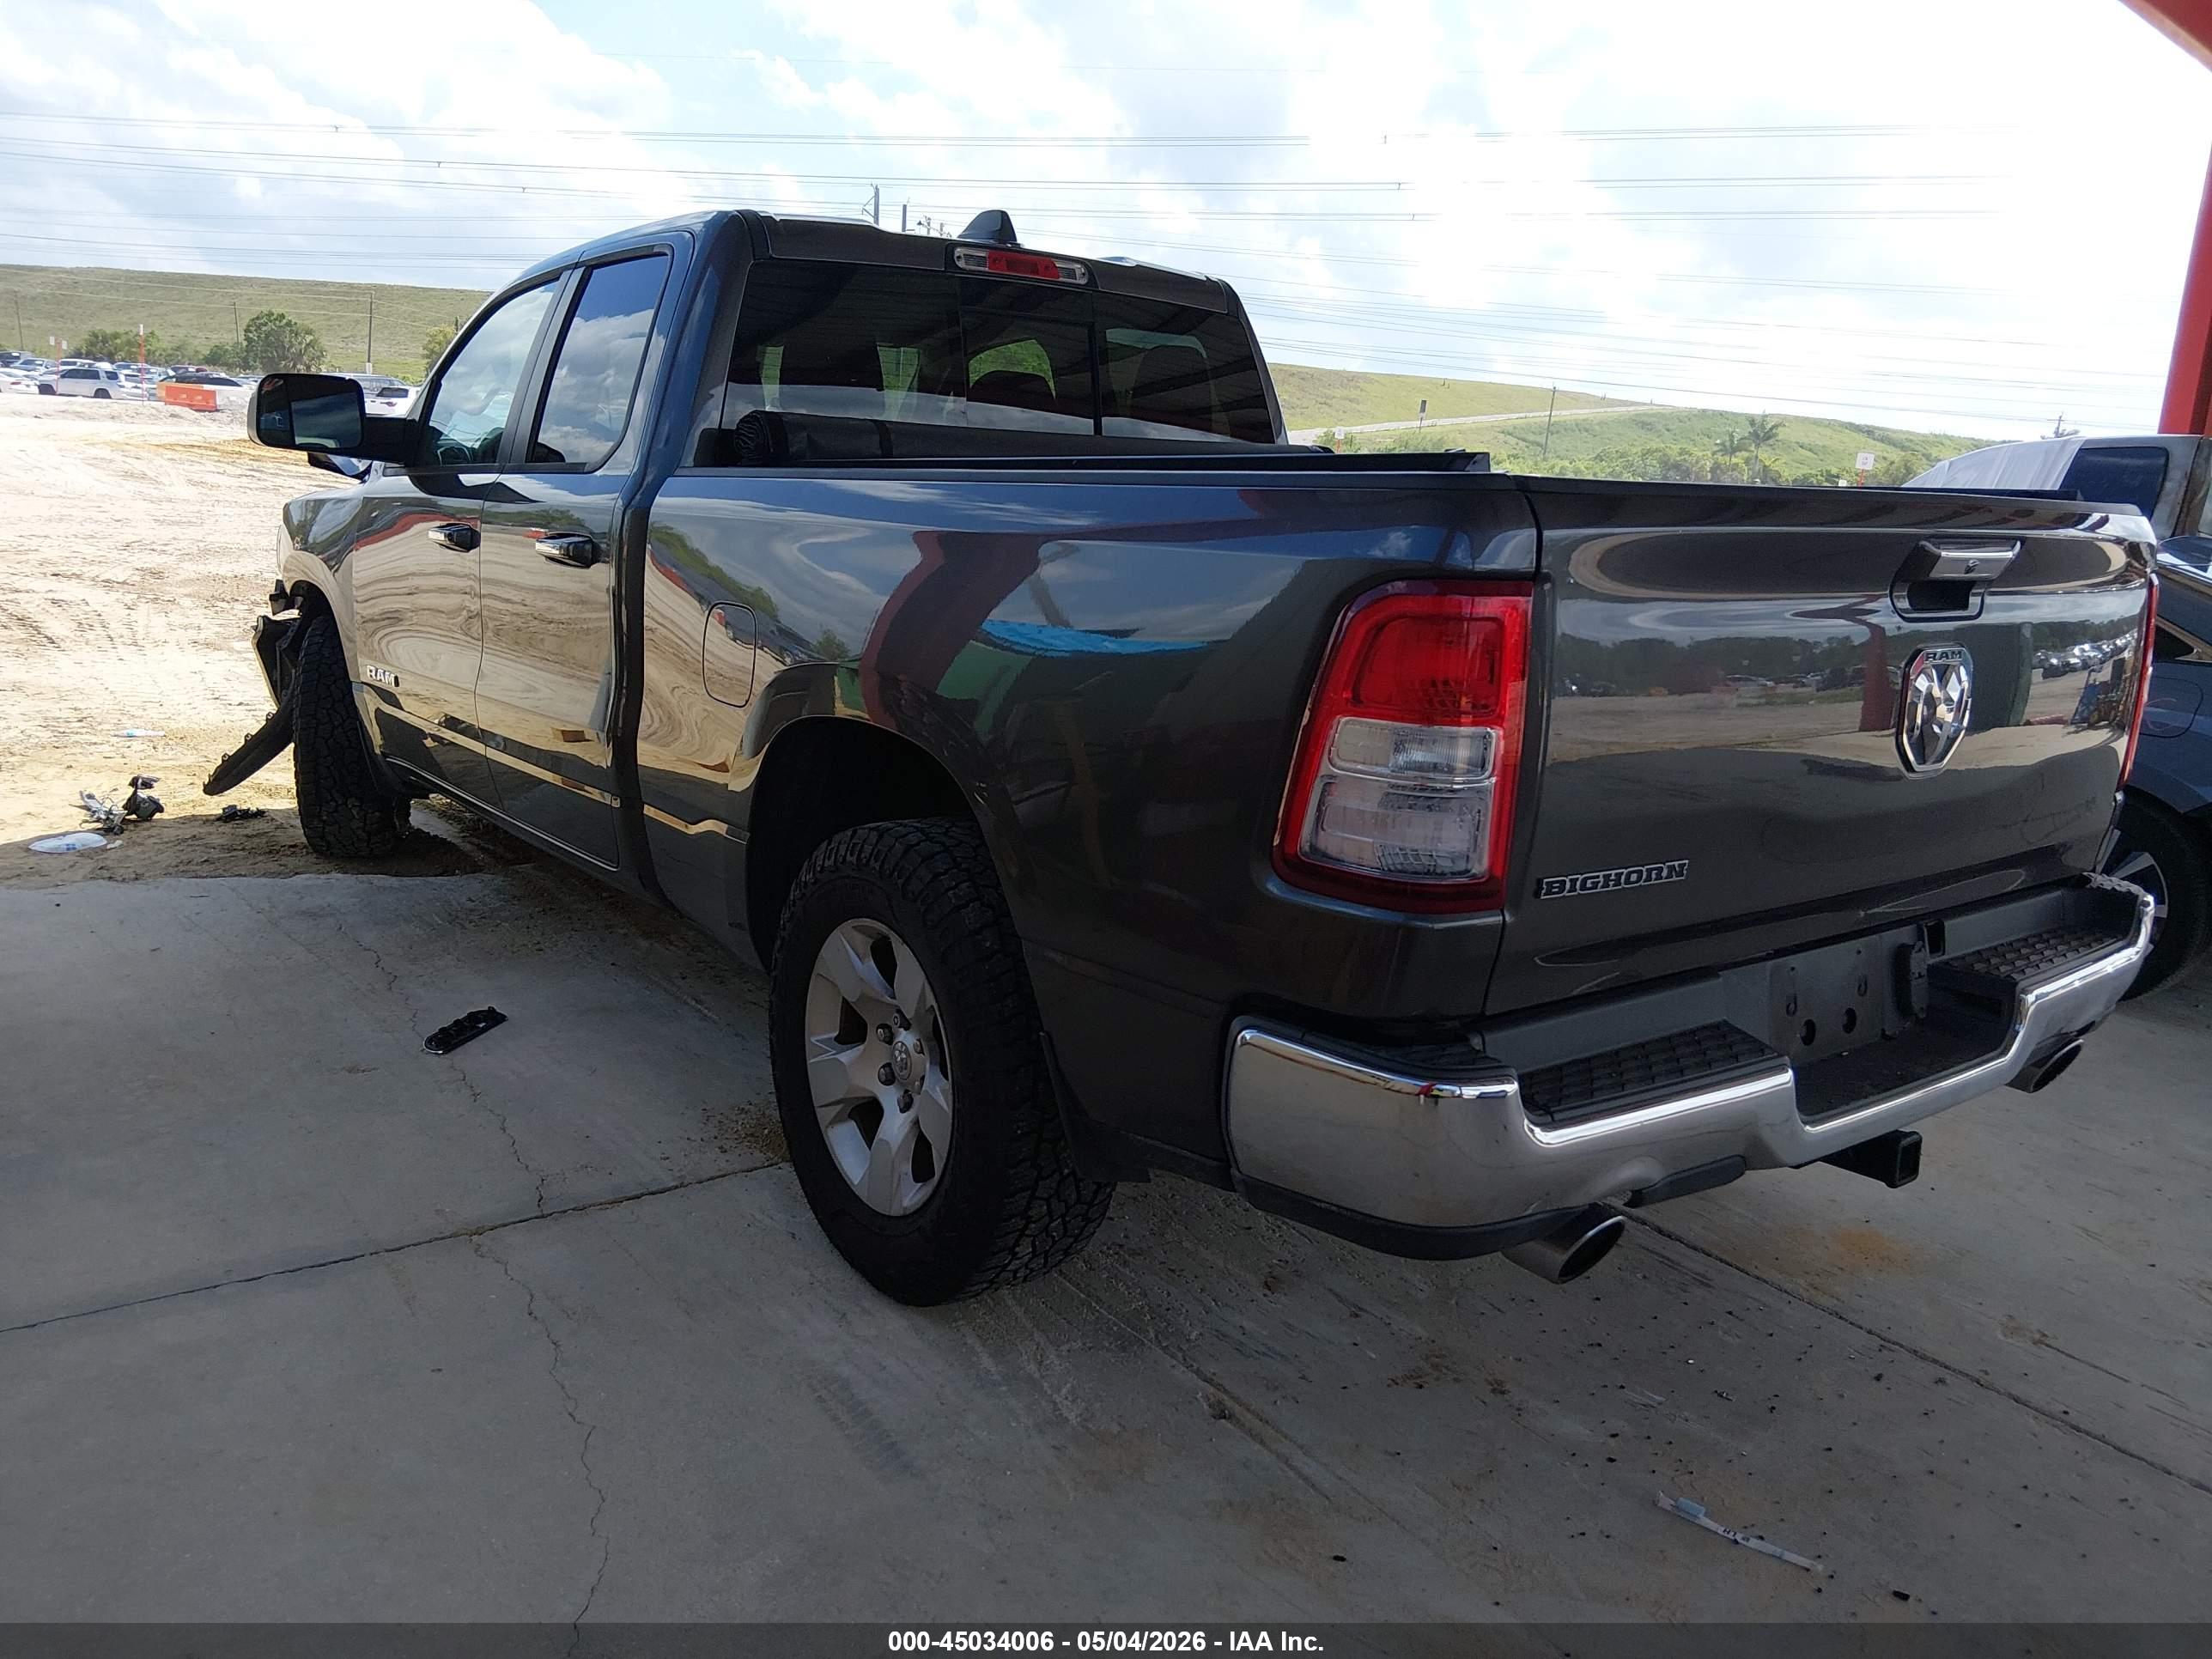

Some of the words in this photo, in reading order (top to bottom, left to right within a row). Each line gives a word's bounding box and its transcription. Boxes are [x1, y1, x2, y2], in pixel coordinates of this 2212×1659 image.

[1924, 651, 1963, 662] RAM
[367, 665, 397, 688] RAM
[1540, 860, 1689, 899] BIGHORN
